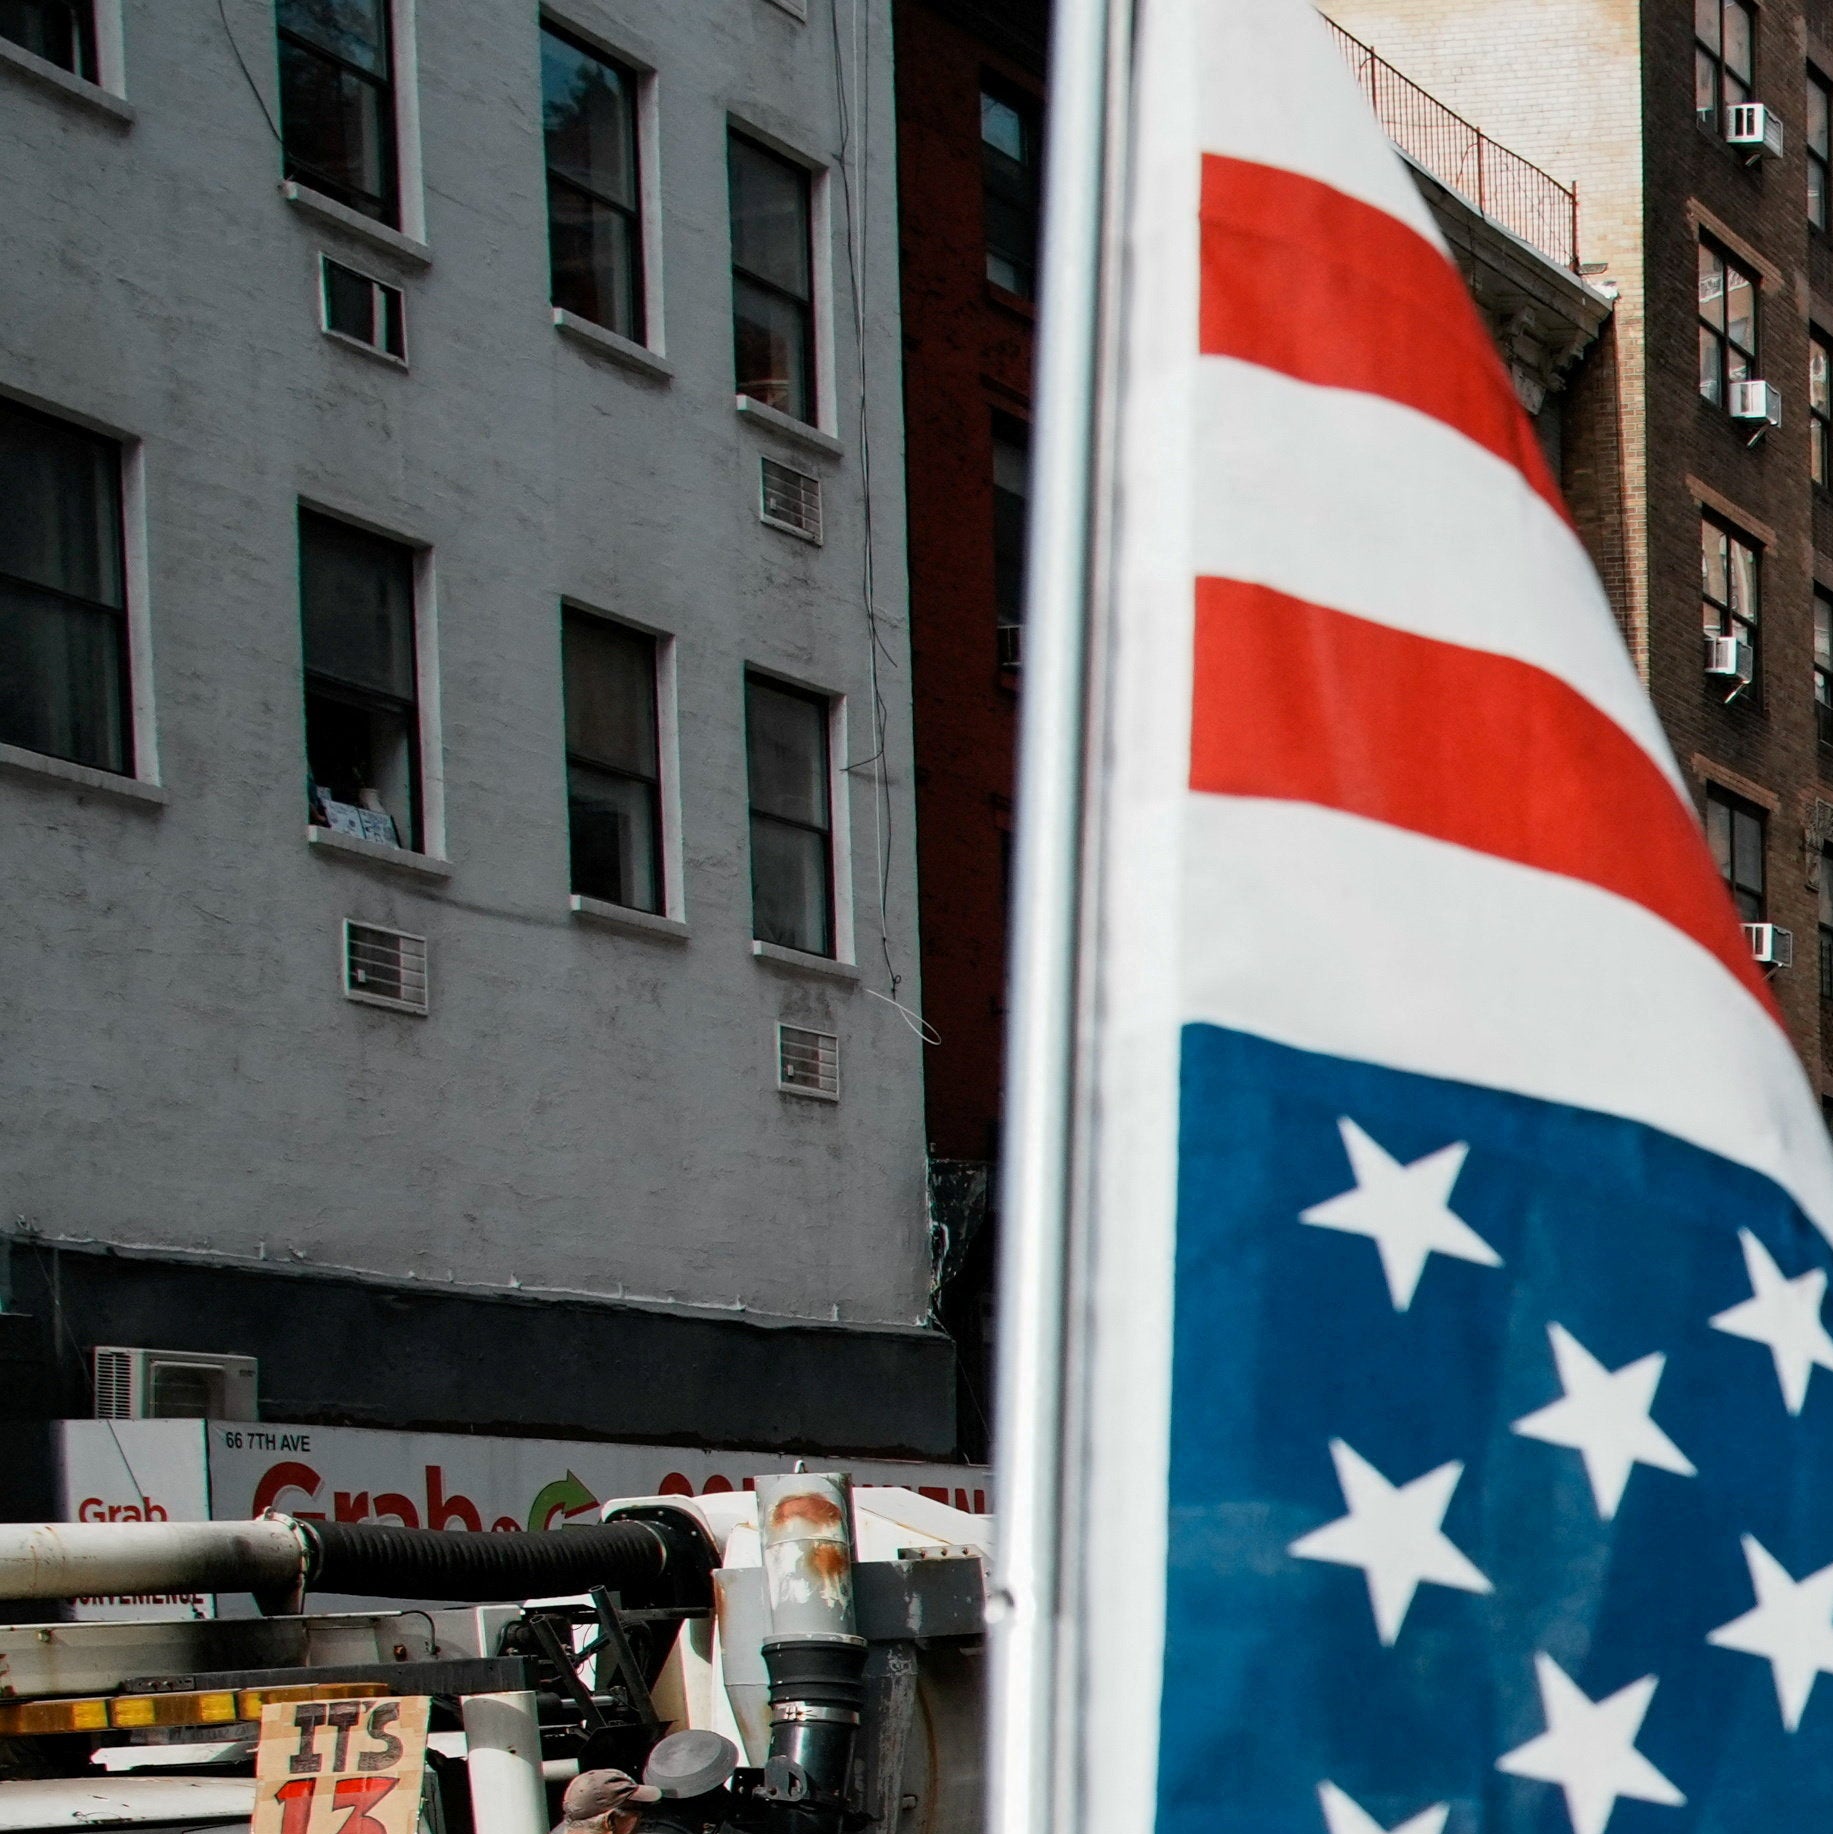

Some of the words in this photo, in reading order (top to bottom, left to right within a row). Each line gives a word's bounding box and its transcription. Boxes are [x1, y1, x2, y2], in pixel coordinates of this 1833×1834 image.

[225, 1431, 244, 1449] 66
[247, 1432, 276, 1451] 7TH
[280, 1434, 311, 1452] AVE
[289, 1701, 404, 1774] IT'S
